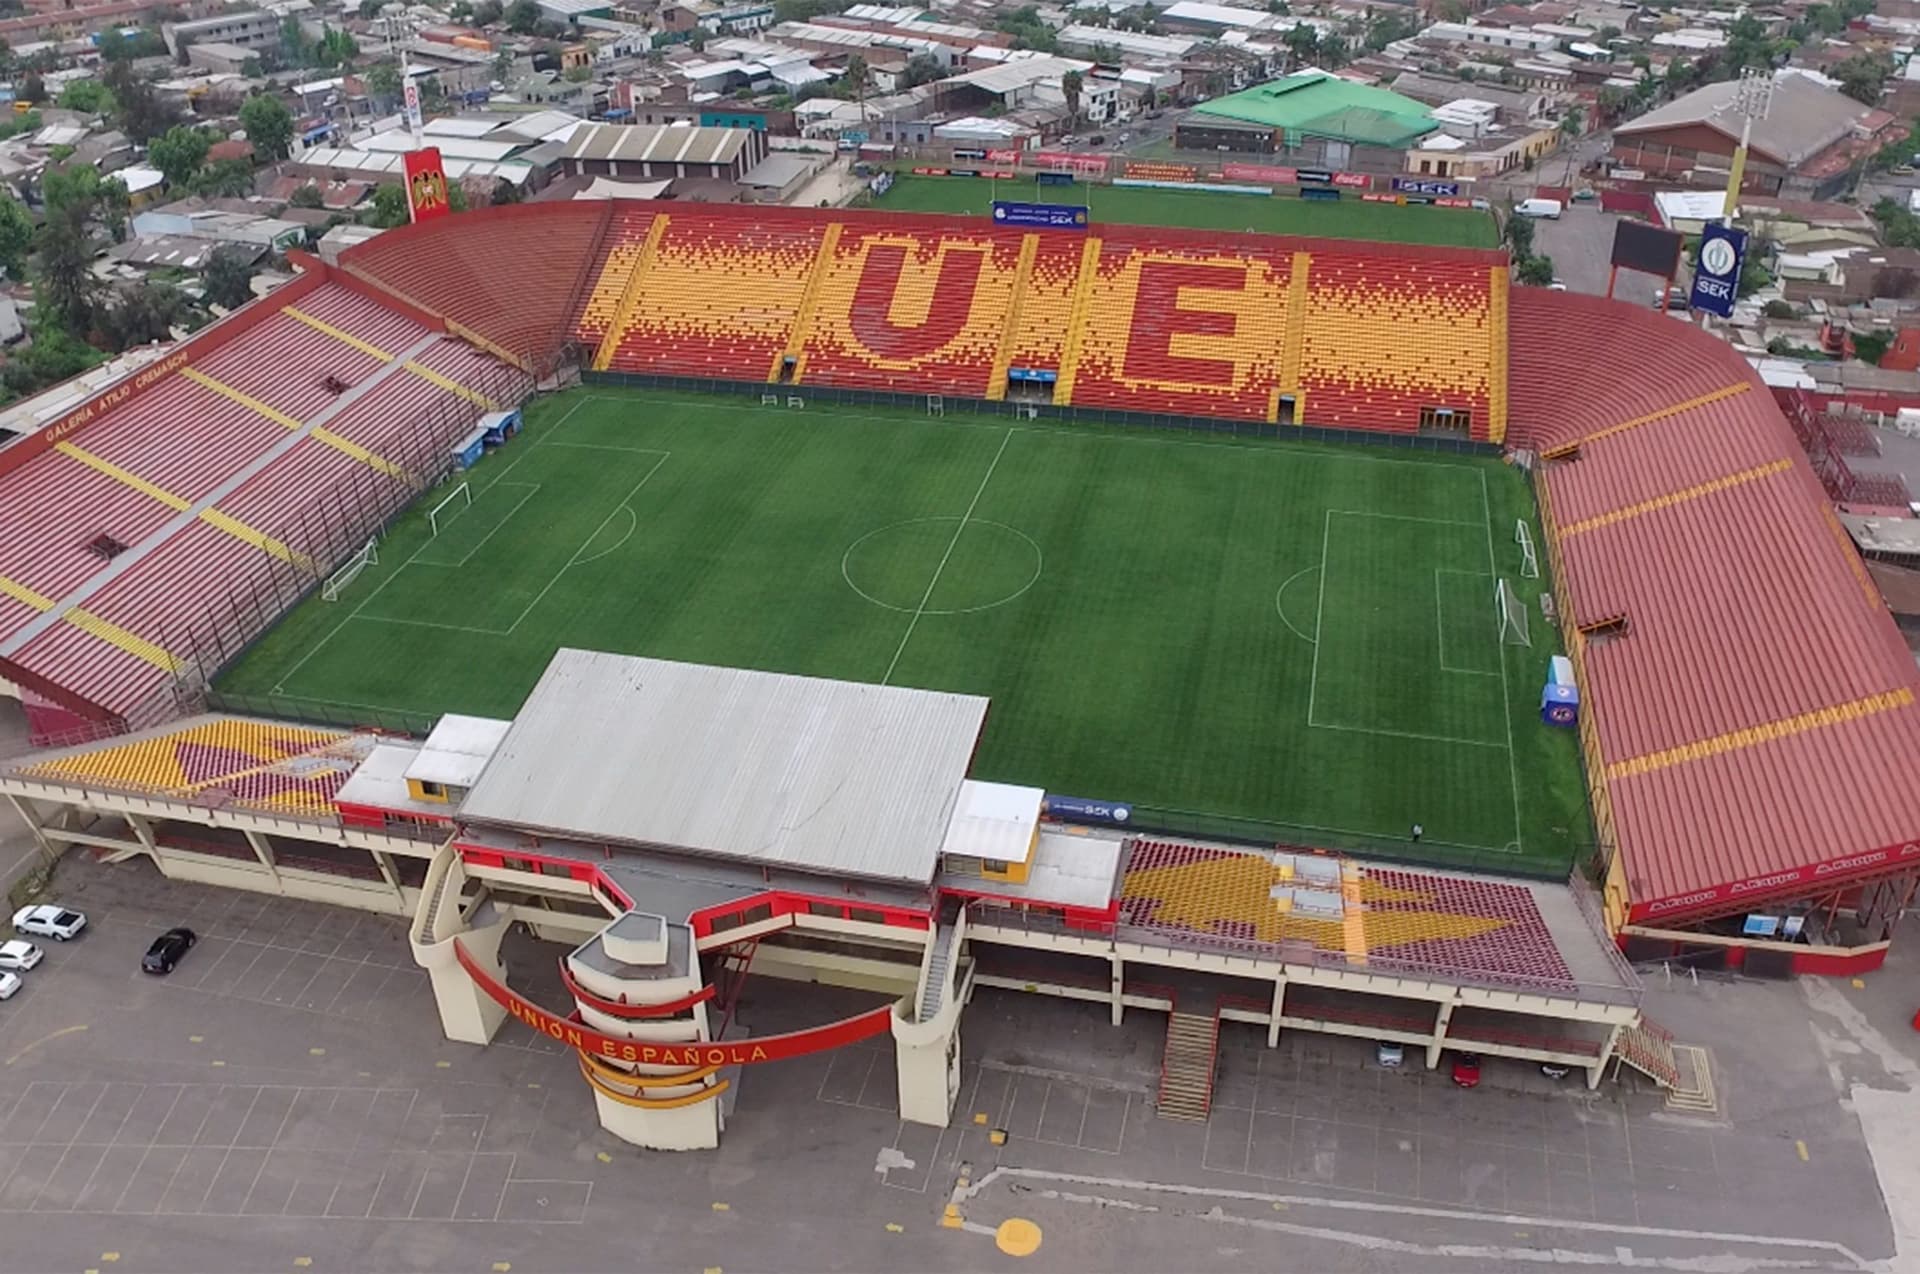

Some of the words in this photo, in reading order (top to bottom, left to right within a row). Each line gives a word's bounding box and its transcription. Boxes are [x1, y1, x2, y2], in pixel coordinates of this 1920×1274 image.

[1697, 280, 1730, 300] SEK
[99, 385, 131, 411] ATILIO
[509, 999, 583, 1046] UNIÓN
[602, 1041, 768, 1065] ESPAÑOLA
